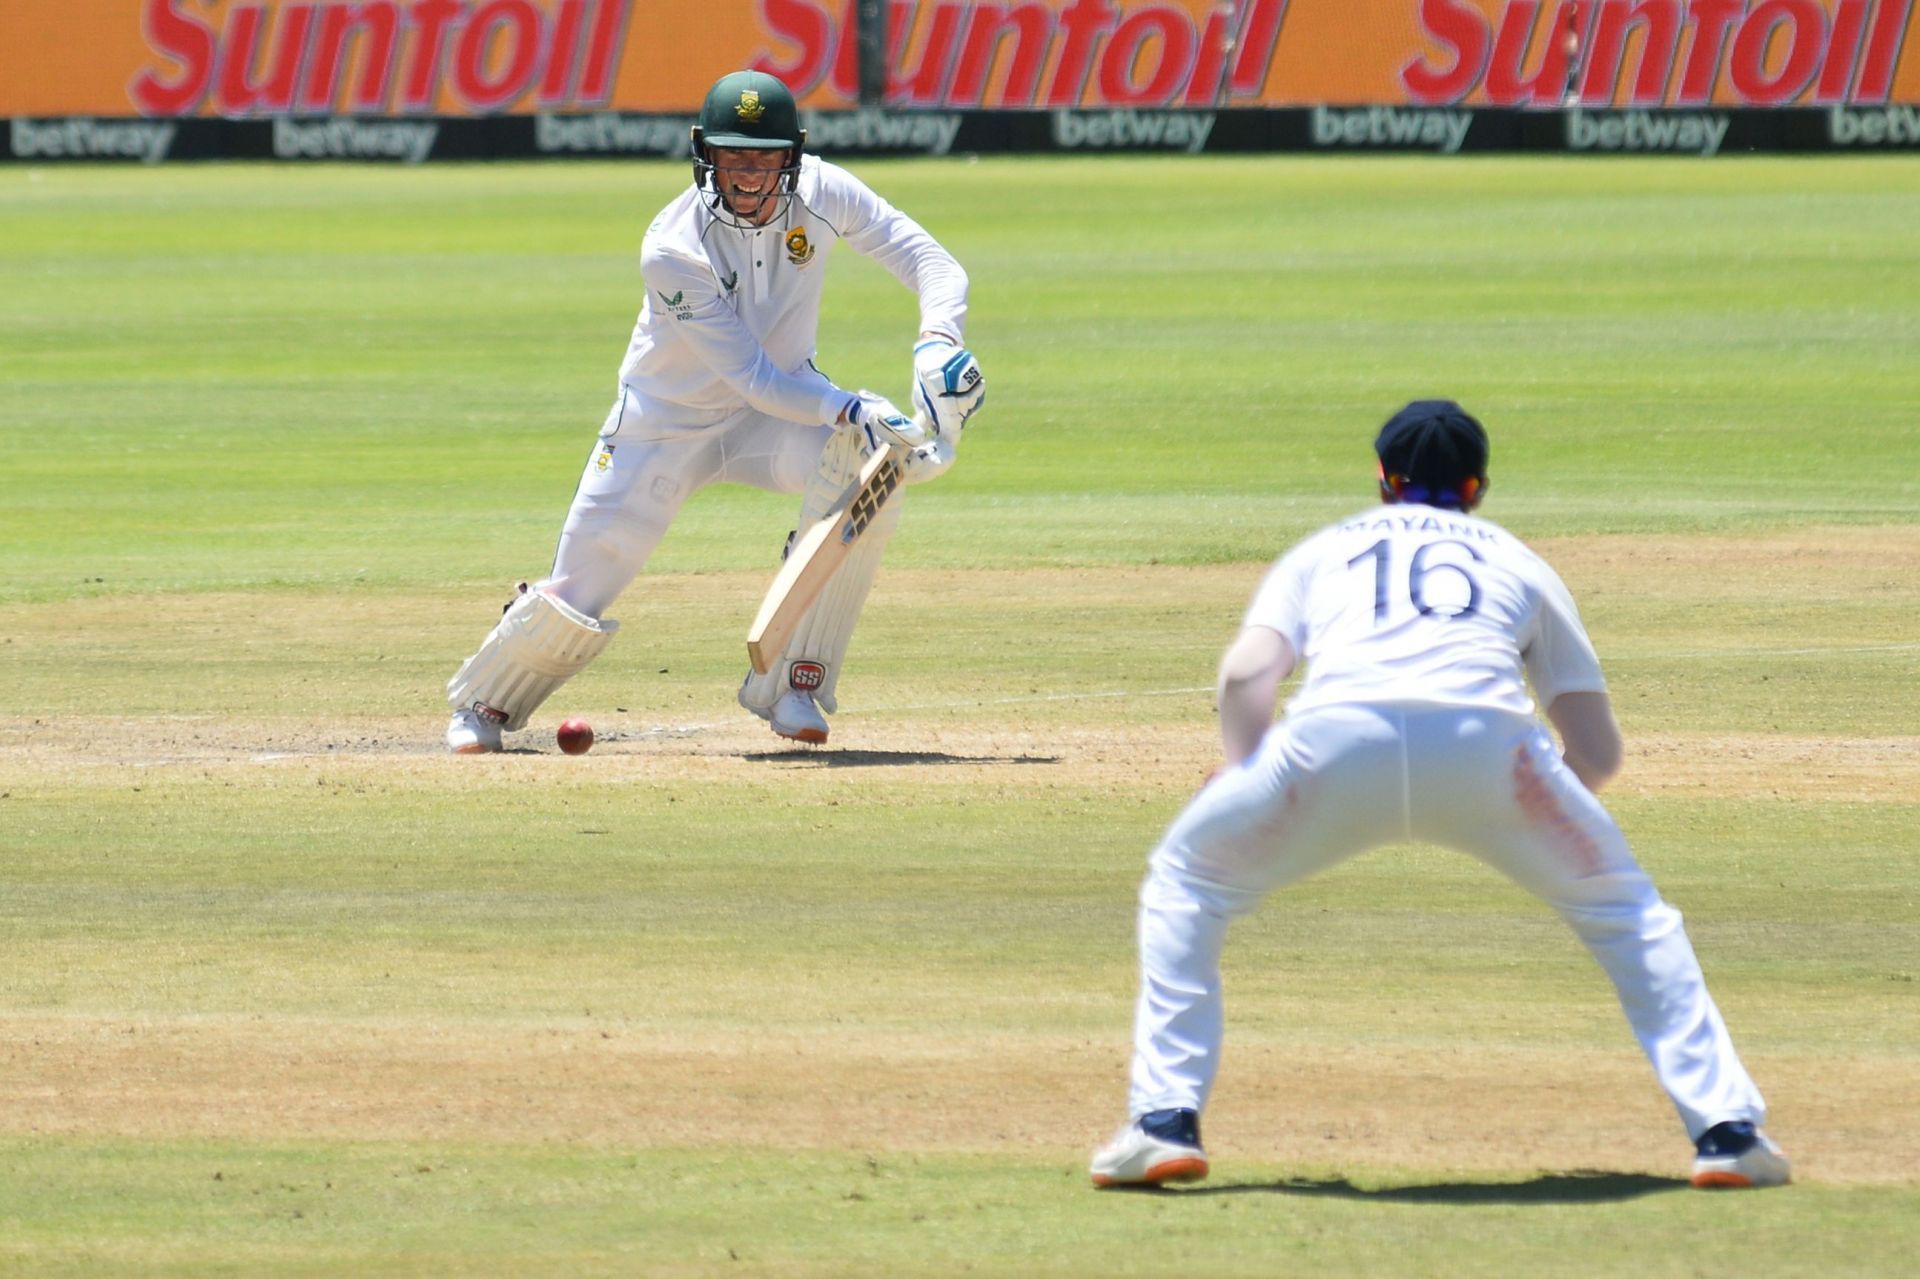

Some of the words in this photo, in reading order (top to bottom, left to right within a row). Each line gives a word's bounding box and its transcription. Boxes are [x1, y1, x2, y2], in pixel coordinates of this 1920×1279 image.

[12, 118, 177, 162] betway
[274, 117, 437, 162] betway
[806, 112, 962, 155] betway
[1055, 110, 1215, 153] betway
[1311, 107, 1473, 151] betway
[1567, 108, 1728, 154] betway
[963, 366, 980, 385] SS
[851, 460, 899, 536] SS
[1338, 516, 1499, 544] MAYANK
[1346, 538, 1484, 626] 16
[795, 670, 819, 685] SS
